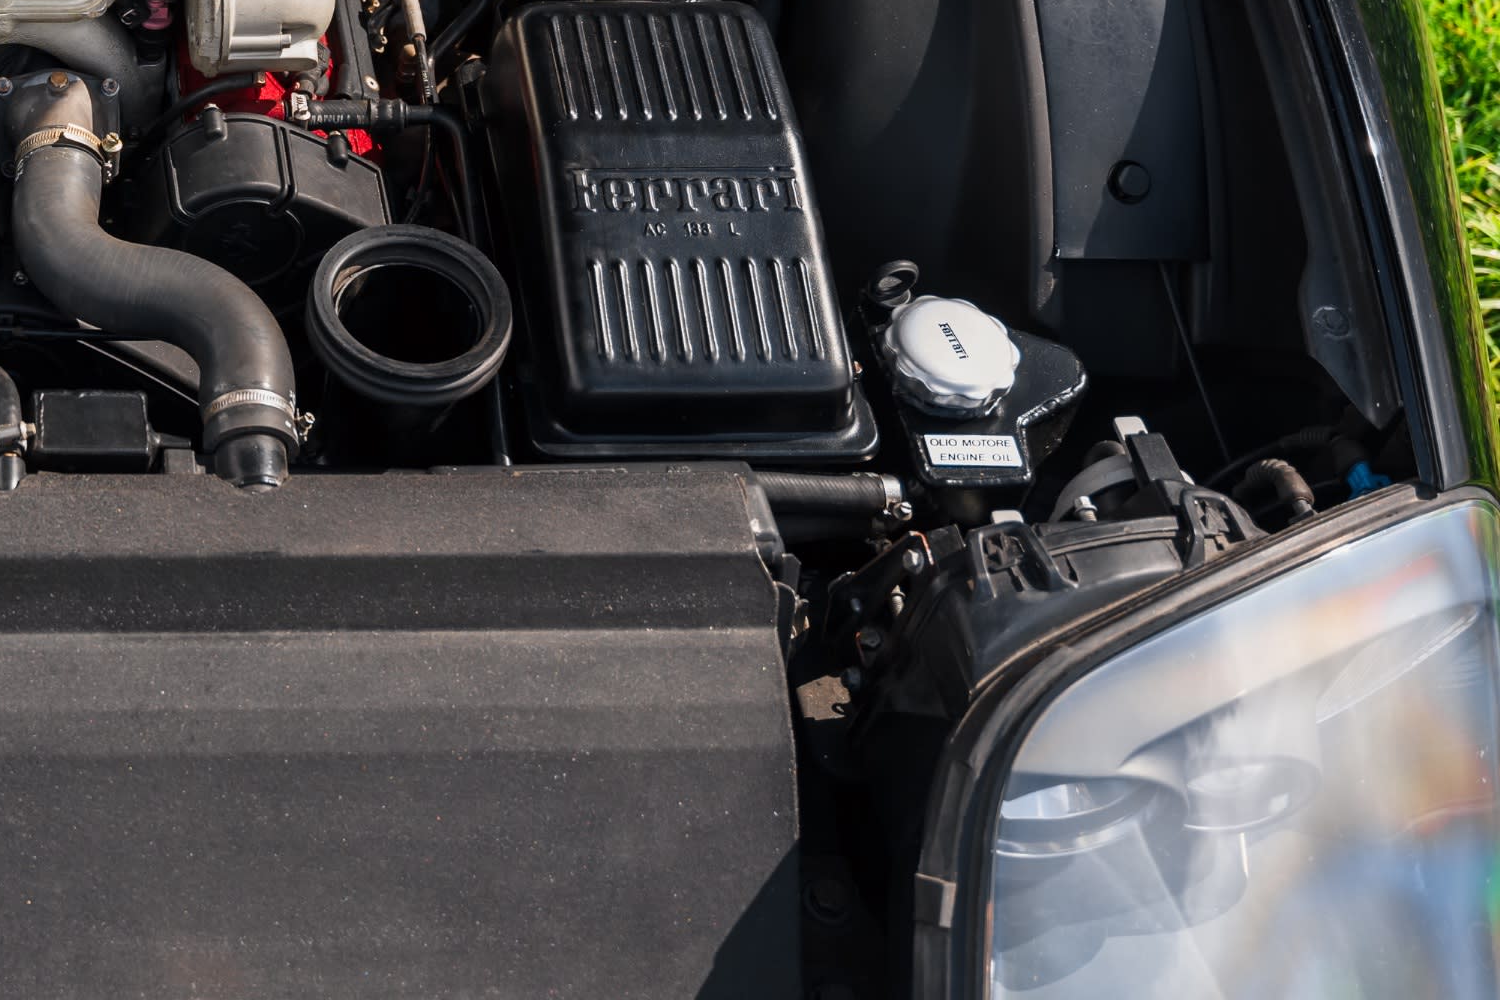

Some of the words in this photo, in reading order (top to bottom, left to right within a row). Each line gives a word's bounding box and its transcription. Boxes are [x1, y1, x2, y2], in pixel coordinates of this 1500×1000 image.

[567, 167, 803, 213] Ferrari
[644, 222, 667, 237] AC
[728, 221, 741, 236] L
[938, 322, 969, 360] Ferrari
[930, 438, 957, 447] OLIO
[962, 438, 1011, 447] MOTORE
[940, 453, 985, 462] ENGINE
[992, 453, 1012, 462] OIL
